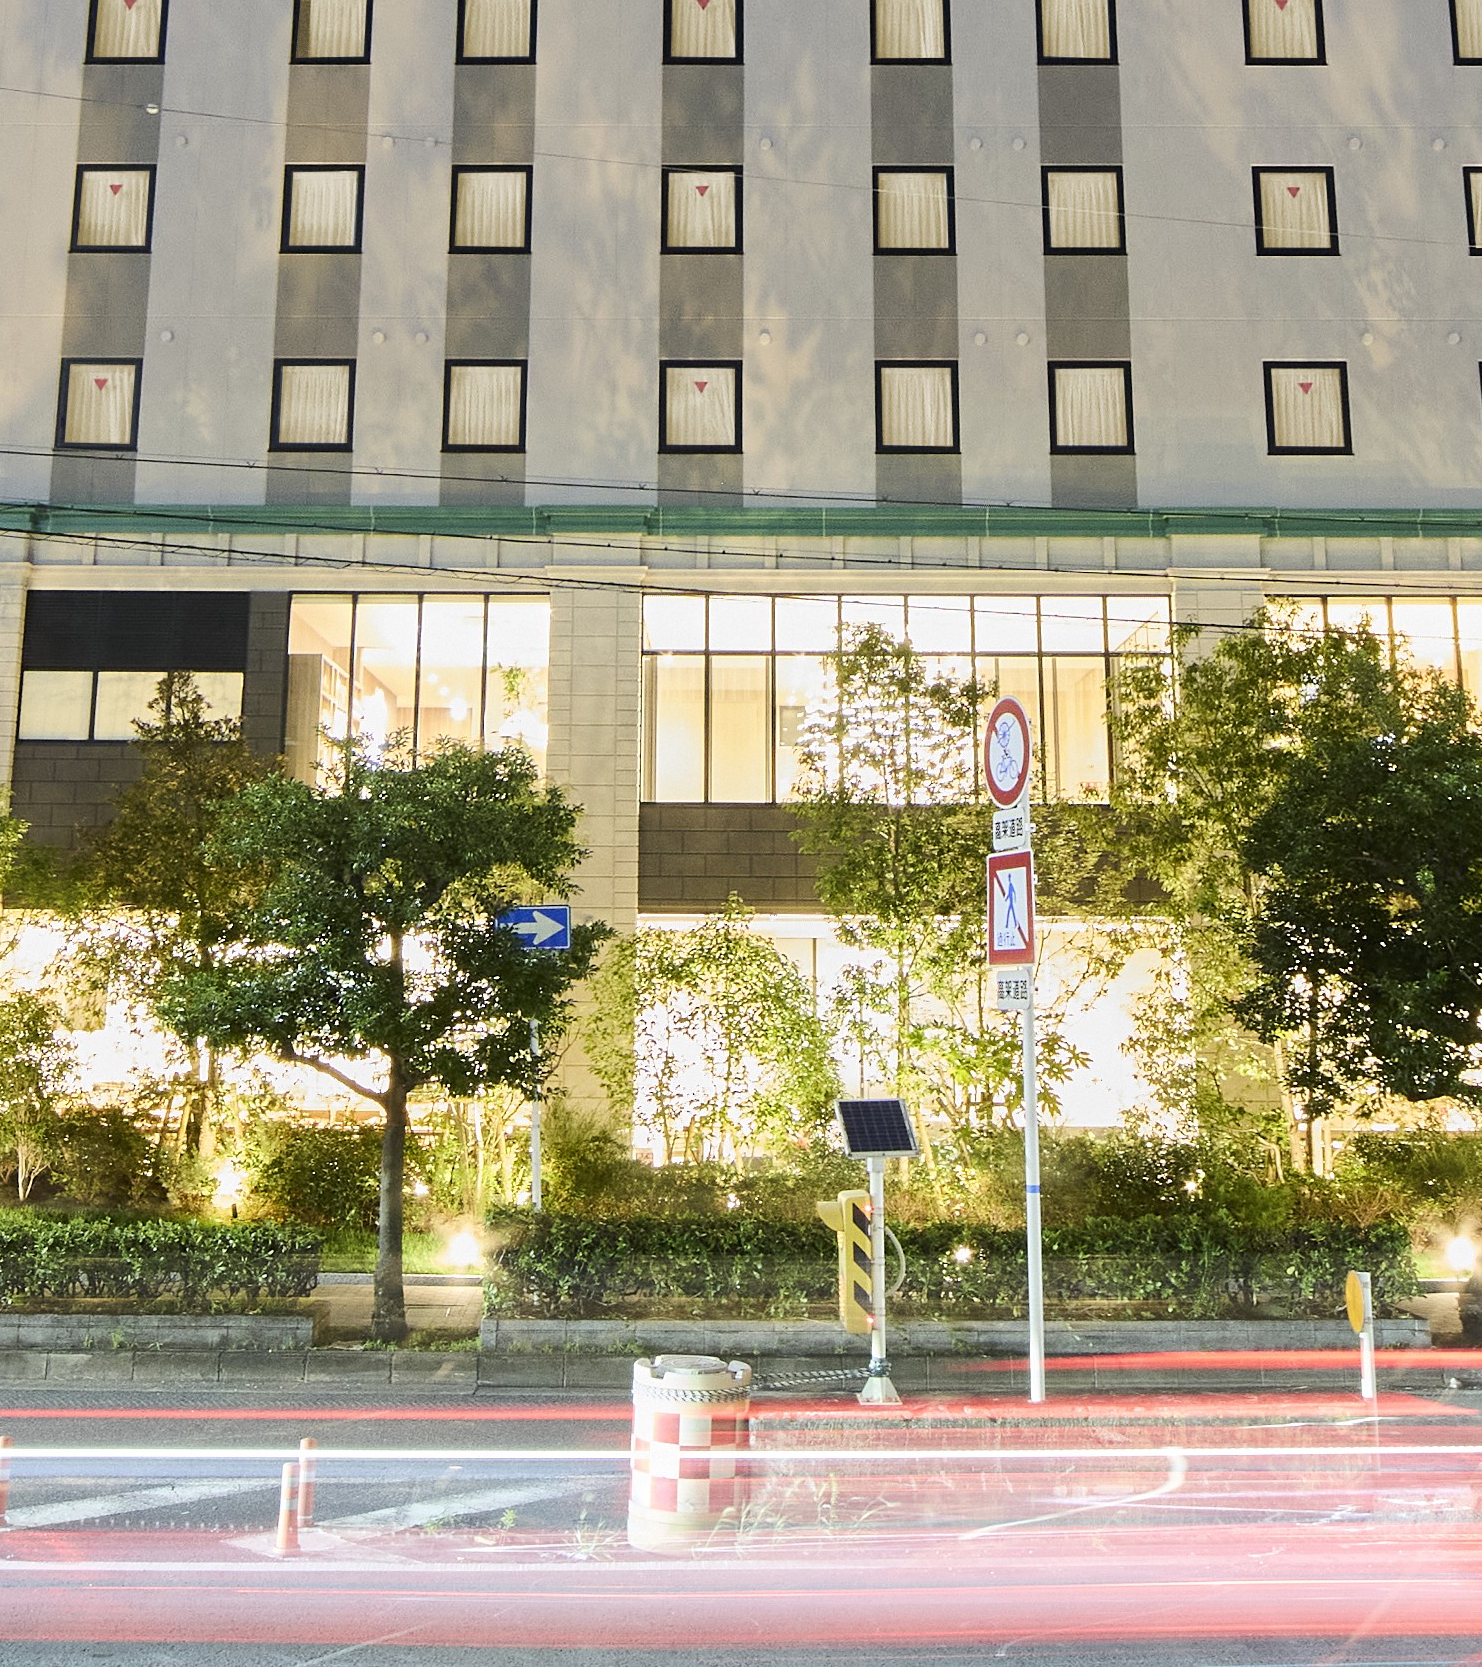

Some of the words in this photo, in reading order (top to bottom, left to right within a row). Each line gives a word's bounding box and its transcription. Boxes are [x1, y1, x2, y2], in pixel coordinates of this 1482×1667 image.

[993, 816, 1023, 840] 高架道路
[998, 979, 1028, 1000] 高架道路
